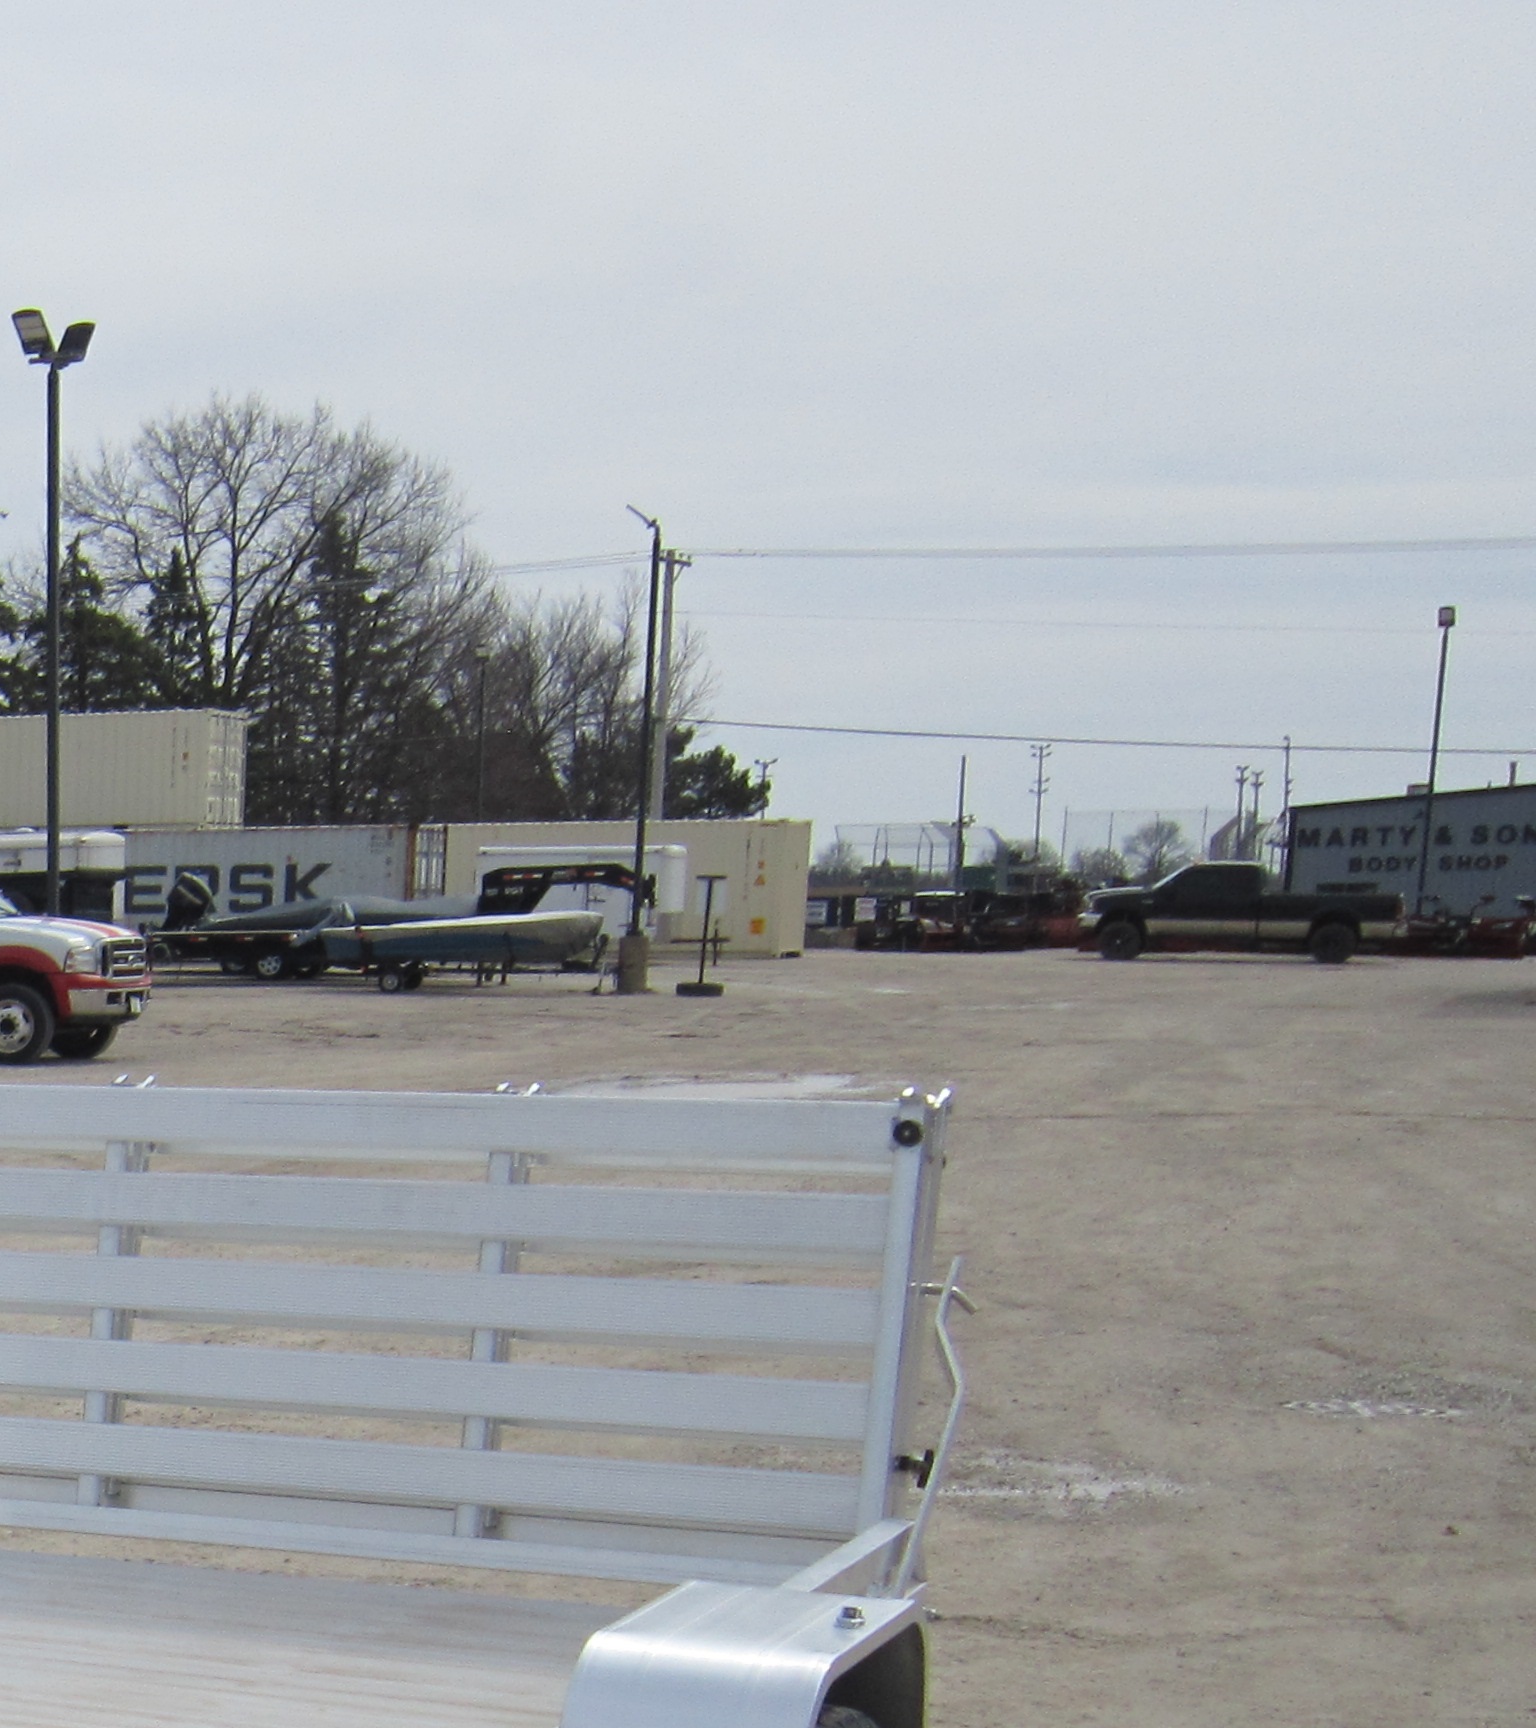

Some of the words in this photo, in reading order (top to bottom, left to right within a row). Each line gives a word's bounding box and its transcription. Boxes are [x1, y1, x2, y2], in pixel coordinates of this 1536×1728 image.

[1298, 825, 1417, 848] MARTY
[1349, 856, 1417, 873] BODY
[1439, 854, 1510, 871] SHOP
